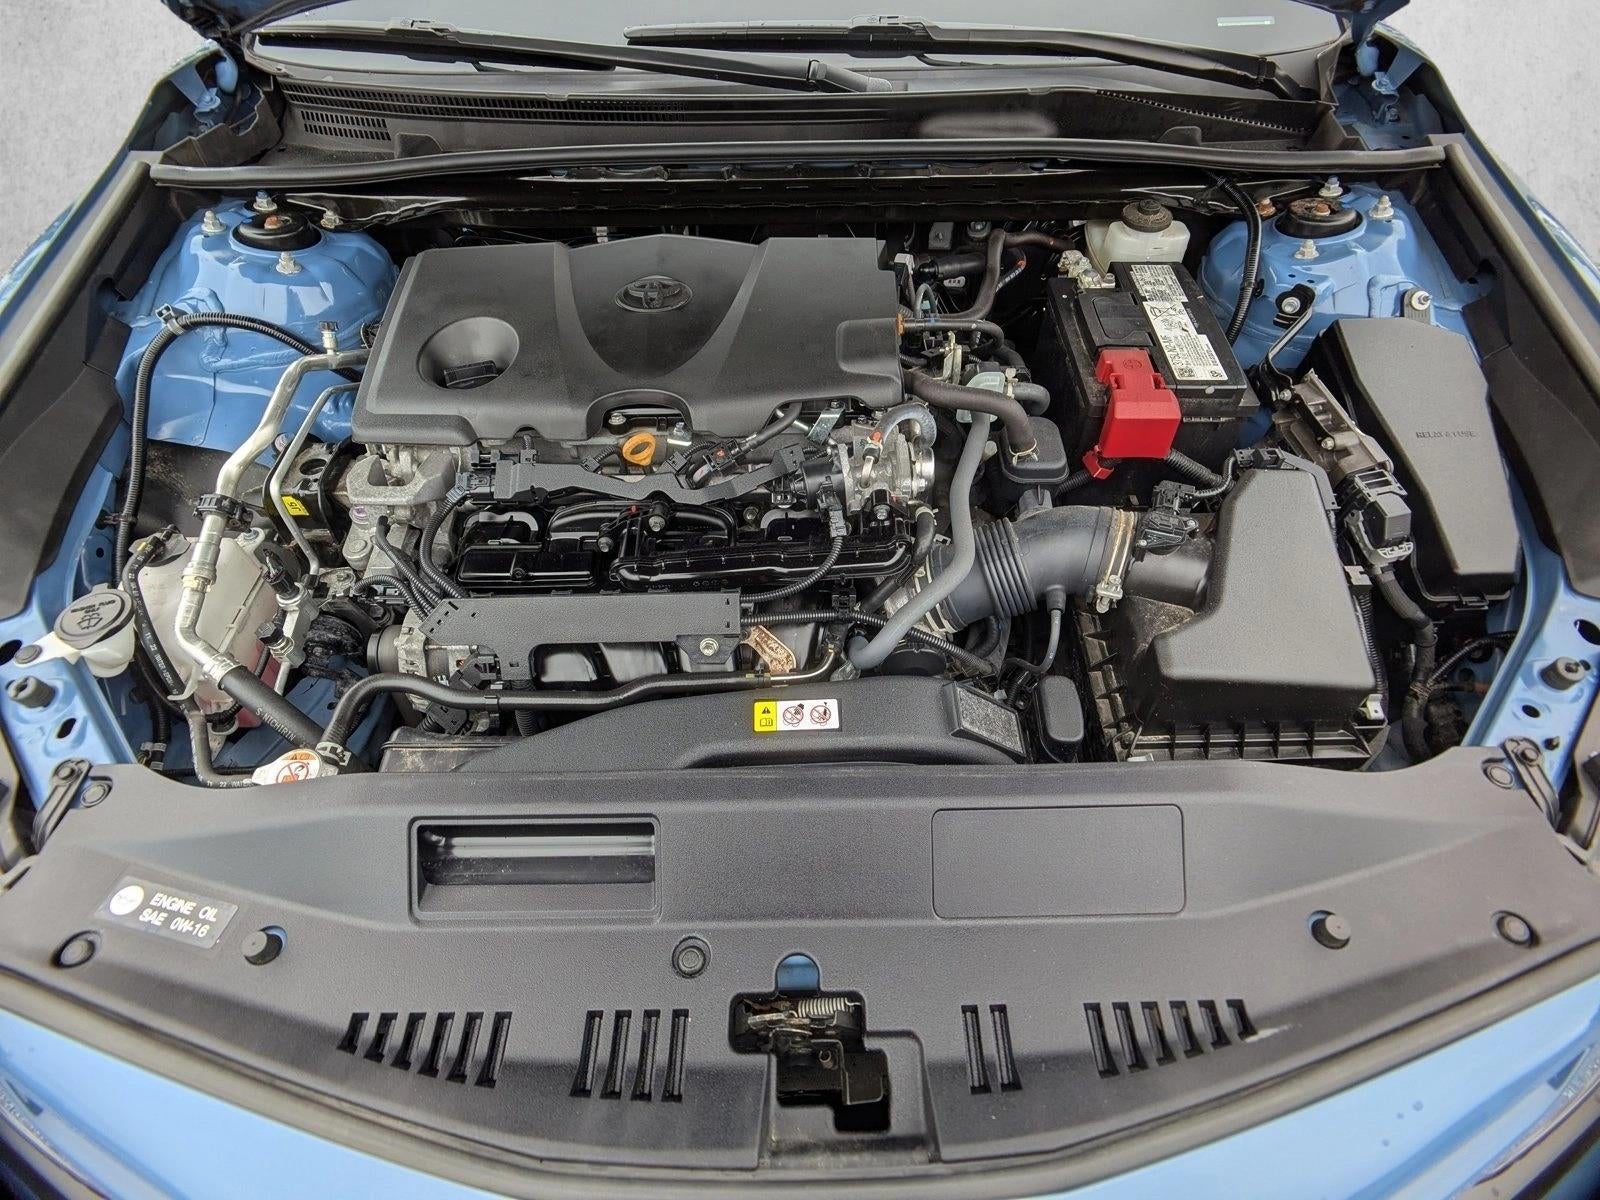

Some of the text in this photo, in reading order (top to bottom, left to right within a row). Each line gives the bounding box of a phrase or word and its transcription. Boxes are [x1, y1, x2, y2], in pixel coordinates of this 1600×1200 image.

[150, 893, 218, 921] ENGINE OIL
[139, 908, 210, 937] SAE 0W-16
